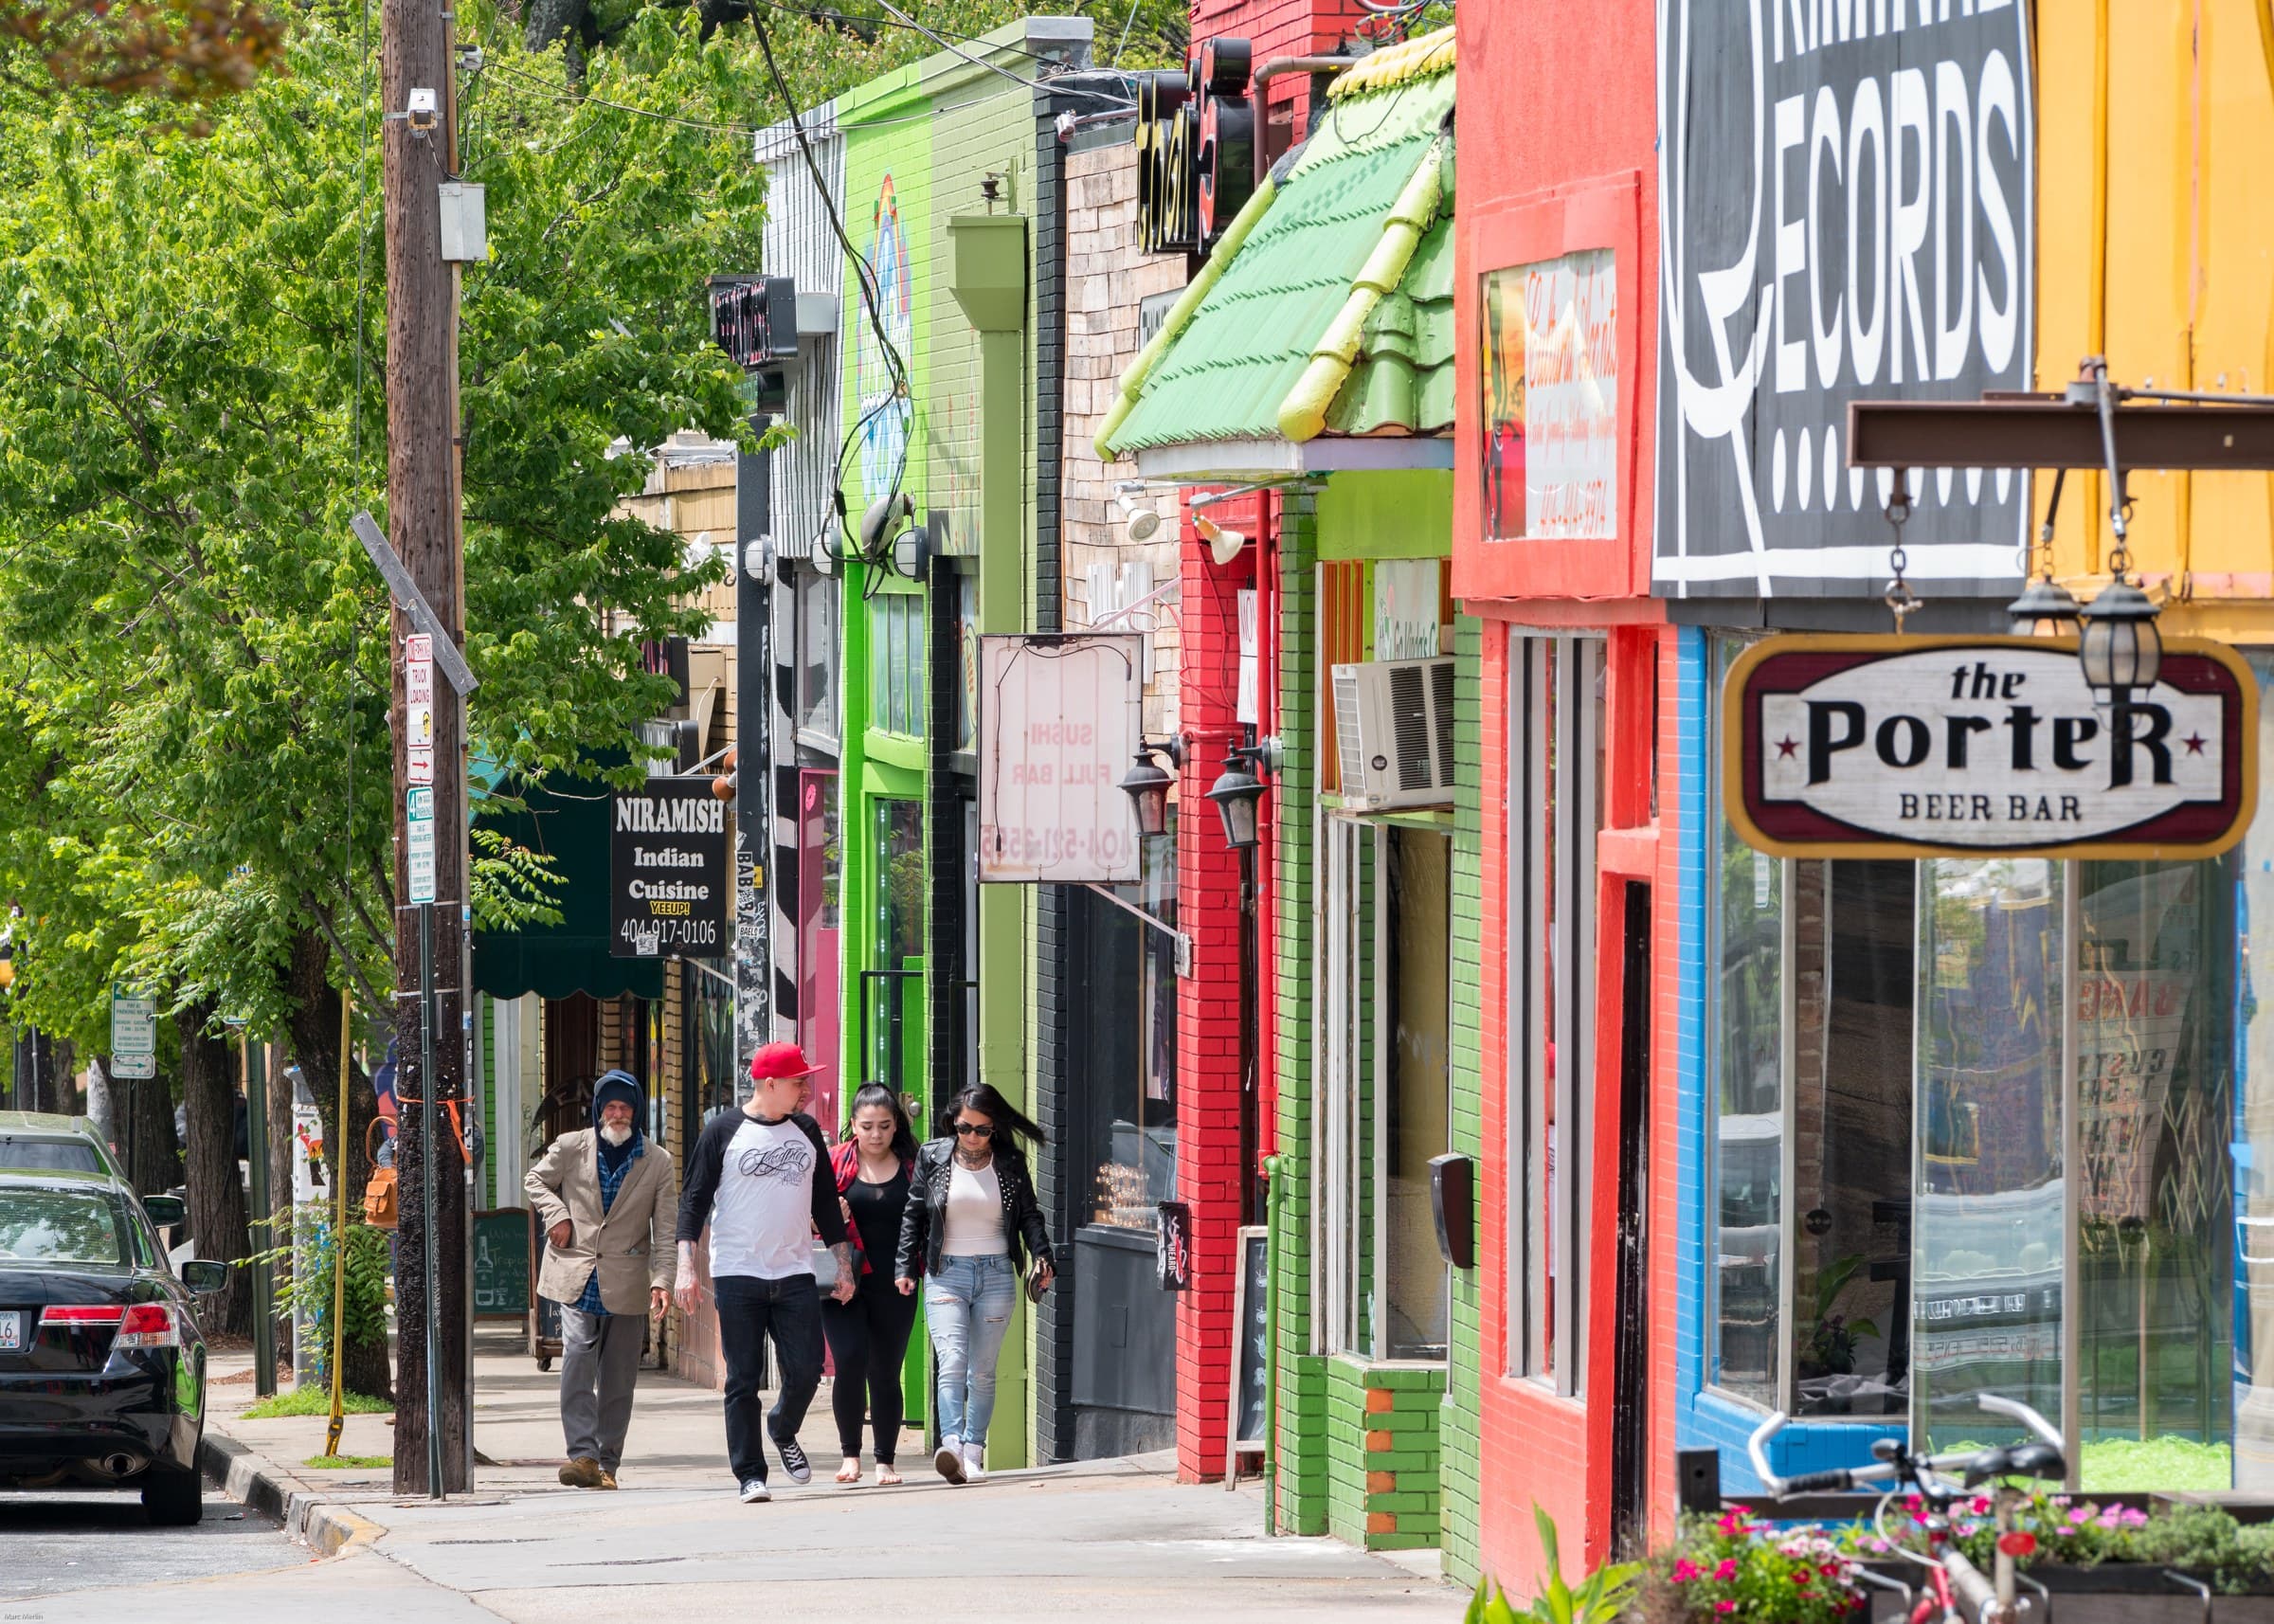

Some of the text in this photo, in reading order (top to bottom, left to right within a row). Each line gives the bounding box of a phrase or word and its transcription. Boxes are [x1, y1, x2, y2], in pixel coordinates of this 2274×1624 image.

[412, 668, 427, 682] TRUCK
[1951, 662, 2026, 700] the
[410, 689, 430, 704] LOADING
[409, 791, 416, 818] 4
[616, 797, 725, 834] NIRAMISH
[1900, 793, 1993, 821] BEER
[2007, 794, 2083, 821] BAR
[634, 846, 704, 868] Indian
[628, 879, 710, 900] Cuisine
[650, 901, 691, 916] YEEUP!
[621, 918, 716, 945] 404-917-0106
